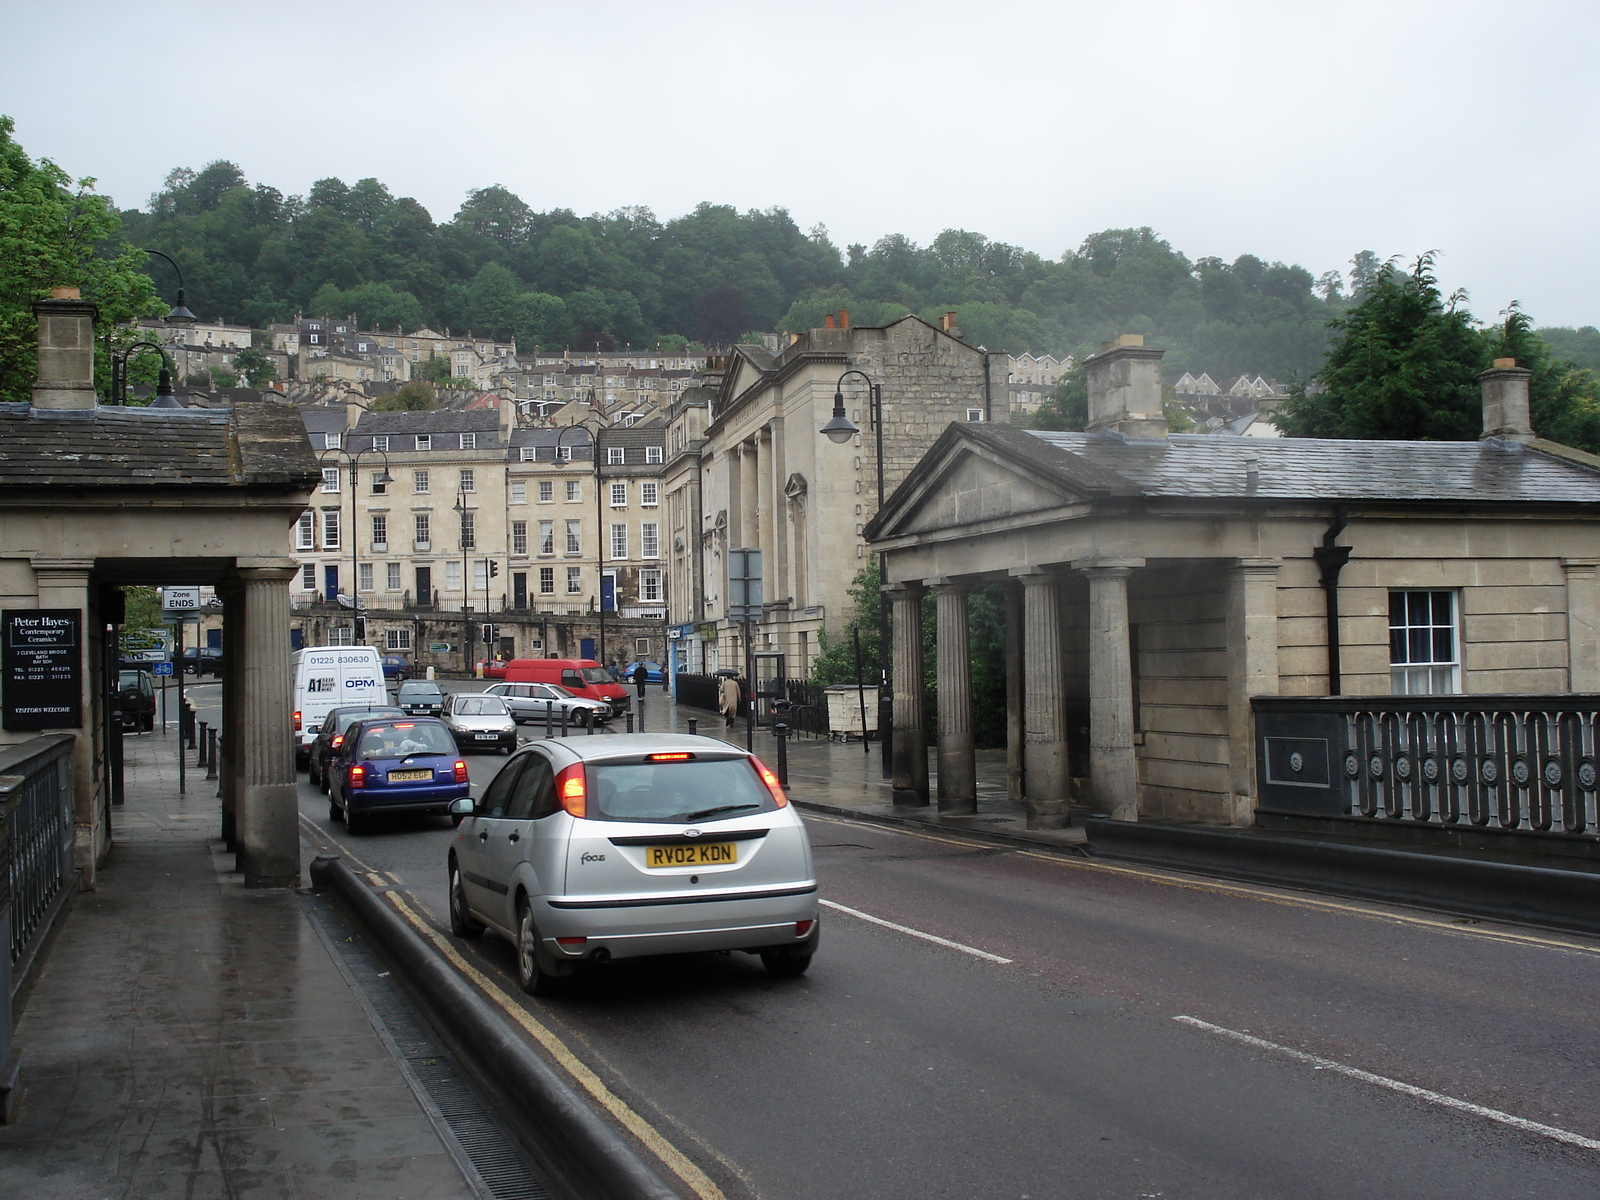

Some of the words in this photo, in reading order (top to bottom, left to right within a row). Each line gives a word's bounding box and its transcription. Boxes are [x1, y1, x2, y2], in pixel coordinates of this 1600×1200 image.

[169, 599, 194, 607] ENDS
[14, 617, 39, 627] Peter
[41, 617, 70, 628] Hayes
[19, 628, 65, 636] Contemporary
[310, 656, 334, 664] 01225
[337, 656, 369, 664] 830630
[308, 678, 322, 692] A1
[345, 680, 375, 688] OPM
[413, 771, 428, 779] EGF
[654, 847, 696, 864] RV02
[700, 845, 732, 862] KDN
